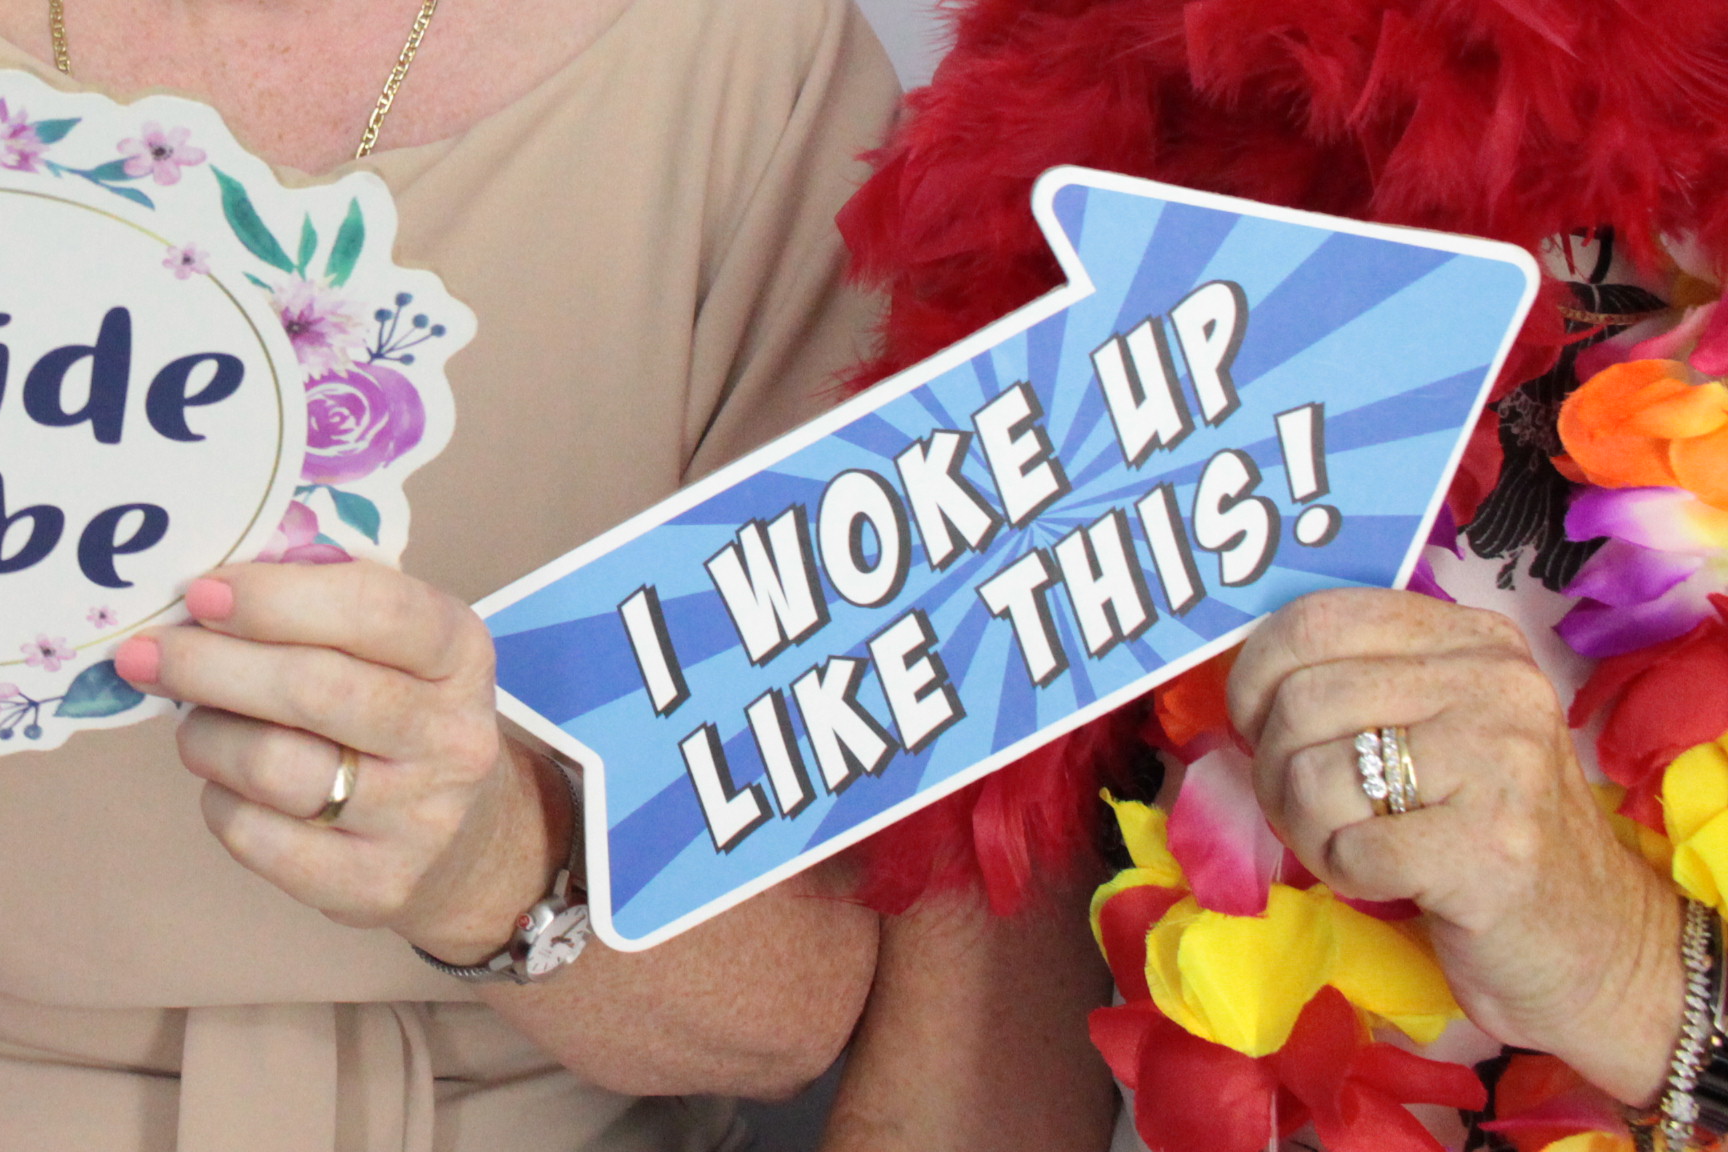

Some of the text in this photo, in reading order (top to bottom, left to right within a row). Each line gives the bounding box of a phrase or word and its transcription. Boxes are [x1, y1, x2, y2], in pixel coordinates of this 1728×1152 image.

[617, 279, 1249, 717] I WOKE UP
[678, 402, 1341, 854] LIKE THIS!
